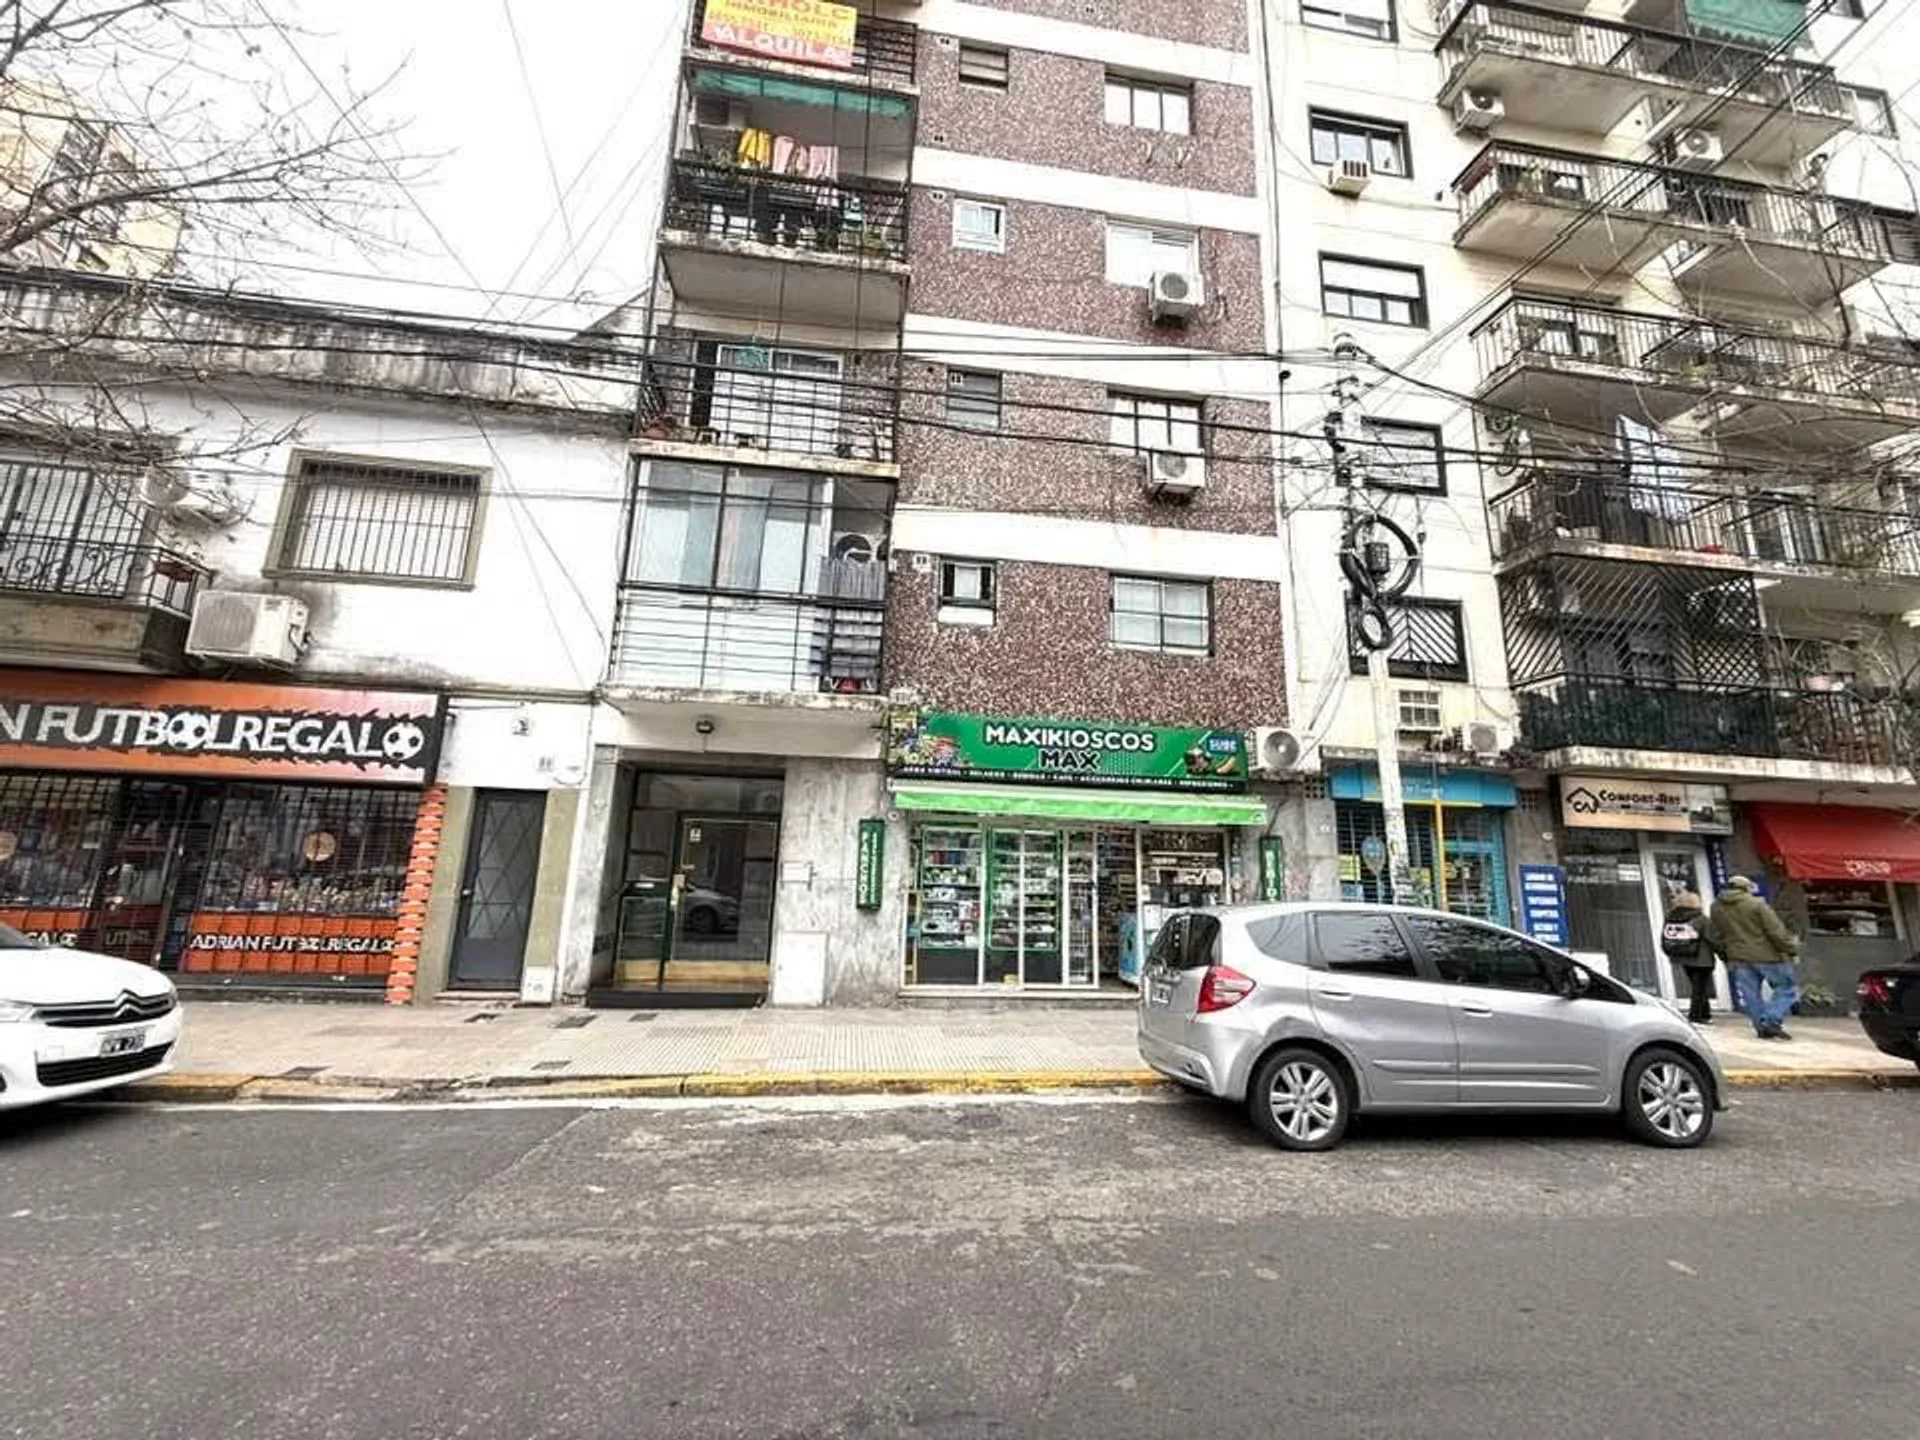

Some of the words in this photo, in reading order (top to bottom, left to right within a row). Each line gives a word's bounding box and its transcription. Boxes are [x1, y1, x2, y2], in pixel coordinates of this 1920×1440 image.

[985, 724, 1155, 751] MAXIKIOSCOS
[1040, 749, 1099, 770] MAX
[190, 934, 260, 950] ADRIAN
